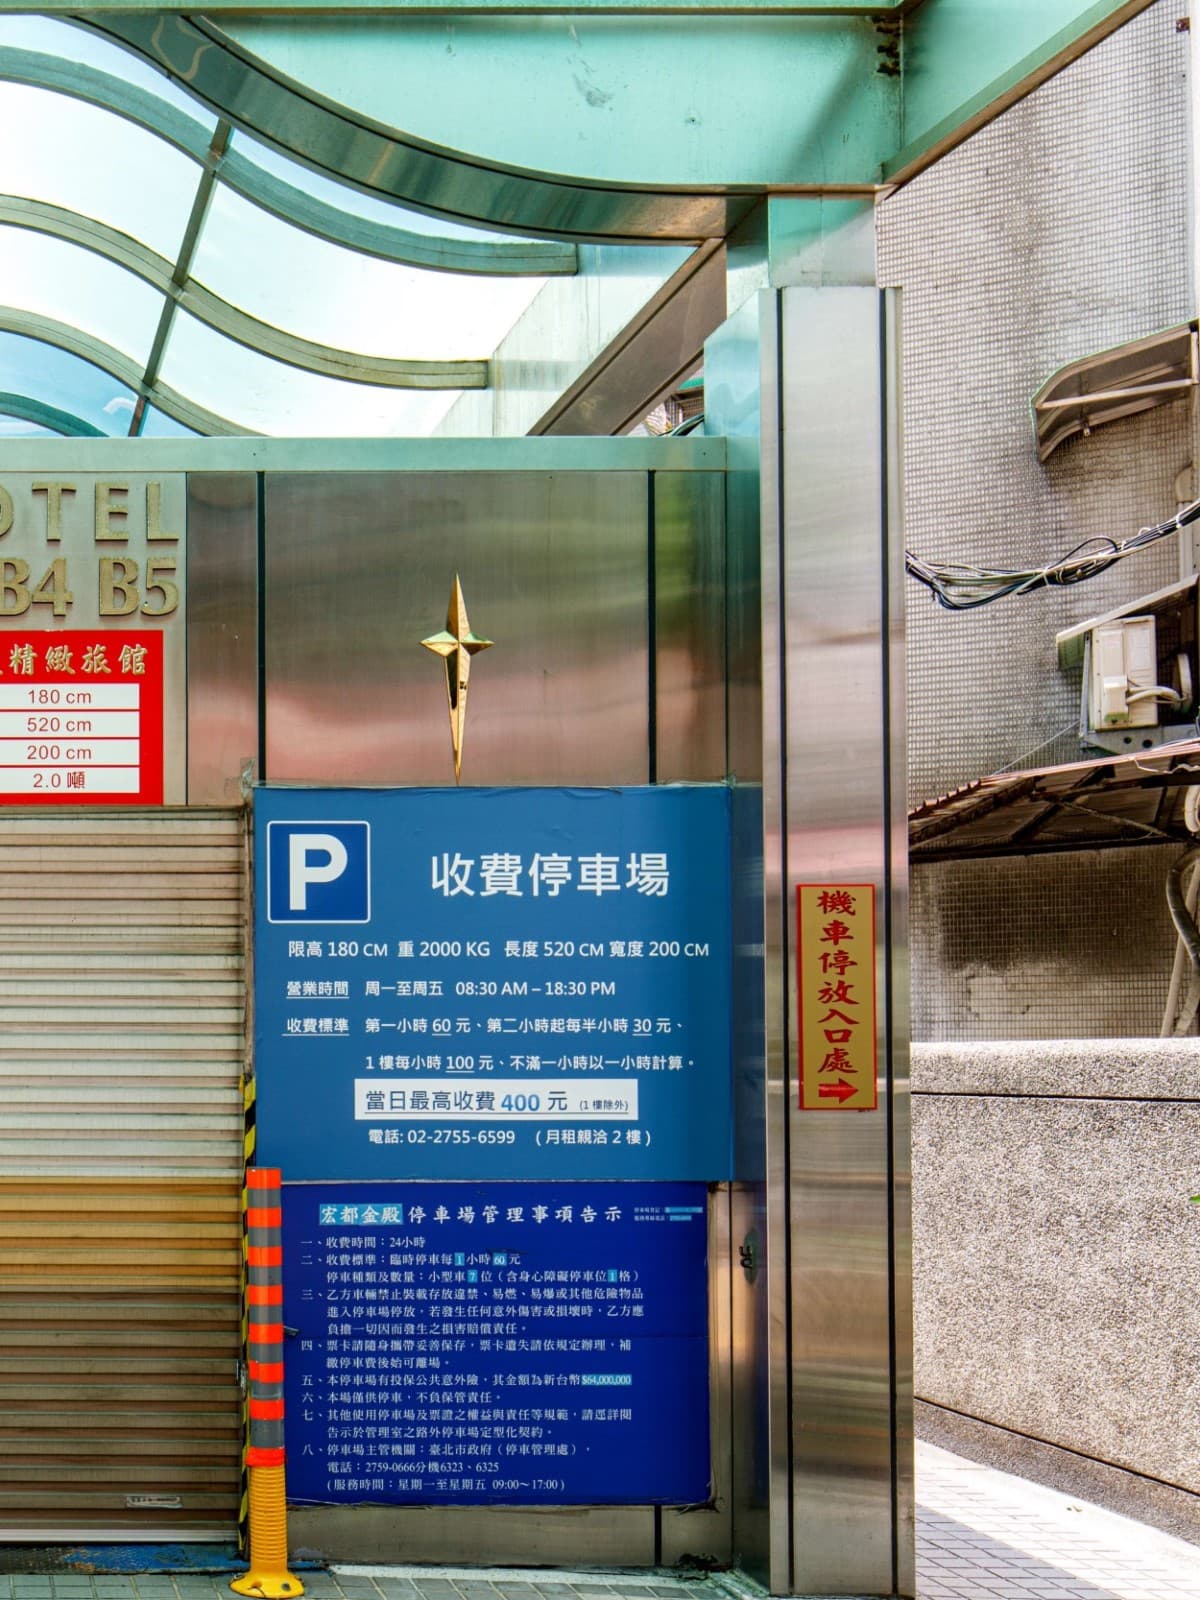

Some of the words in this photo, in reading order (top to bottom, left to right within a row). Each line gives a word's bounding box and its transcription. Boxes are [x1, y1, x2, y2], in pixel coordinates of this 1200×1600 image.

[99, 557, 179, 617] B5
[28, 690, 61, 704] 180
[65, 692, 92, 704] cm
[27, 718, 61, 732] 520
[65, 720, 92, 732] cm
[27, 746, 61, 760] 200
[65, 748, 92, 760] cm
[33, 773, 61, 788] 2.0
[289, 834, 348, 911] P
[431, 852, 670, 897] 收費停車場
[288, 940, 323, 958] 限高
[328, 942, 359, 957] 180
[363, 944, 388, 957] CM
[397, 940, 415, 958] 重
[419, 942, 462, 957] 2000
[466, 942, 491, 957] KG
[504, 940, 539, 958] 長度
[543, 942, 575, 957] 520
[579, 944, 604, 957] CM
[609, 940, 644, 958] 寬度
[648, 942, 680, 957] 200
[684, 944, 710, 957] CM
[286, 980, 349, 997] 營業時間
[365, 980, 444, 997] 周一至周五
[455, 982, 498, 996] 08:30
[501, 982, 528, 996] AM
[545, 982, 587, 996] 18:30
[590, 982, 616, 996] PM
[816, 890, 860, 1074] 機車停放入口處
[286, 1017, 349, 1034] 收費標準
[365, 1017, 428, 1034] 第一小時
[431, 1019, 452, 1034] 60
[632, 1019, 652, 1034] 30
[366, 1057, 375, 1071] 1
[378, 1055, 442, 1072] 樓每小時
[445, 1057, 475, 1071] 100
[365, 1090, 496, 1112] 當日最高收費
[500, 1093, 541, 1112] 400
[547, 1091, 568, 1111] 元
[368, 1129, 404, 1145] 電話:
[407, 1130, 516, 1145] 02-2755-6599
[612, 1131, 621, 1145] 2
[320, 1205, 402, 1225] 宏都金殿
[408, 1204, 623, 1225] 停車場管理事項告示
